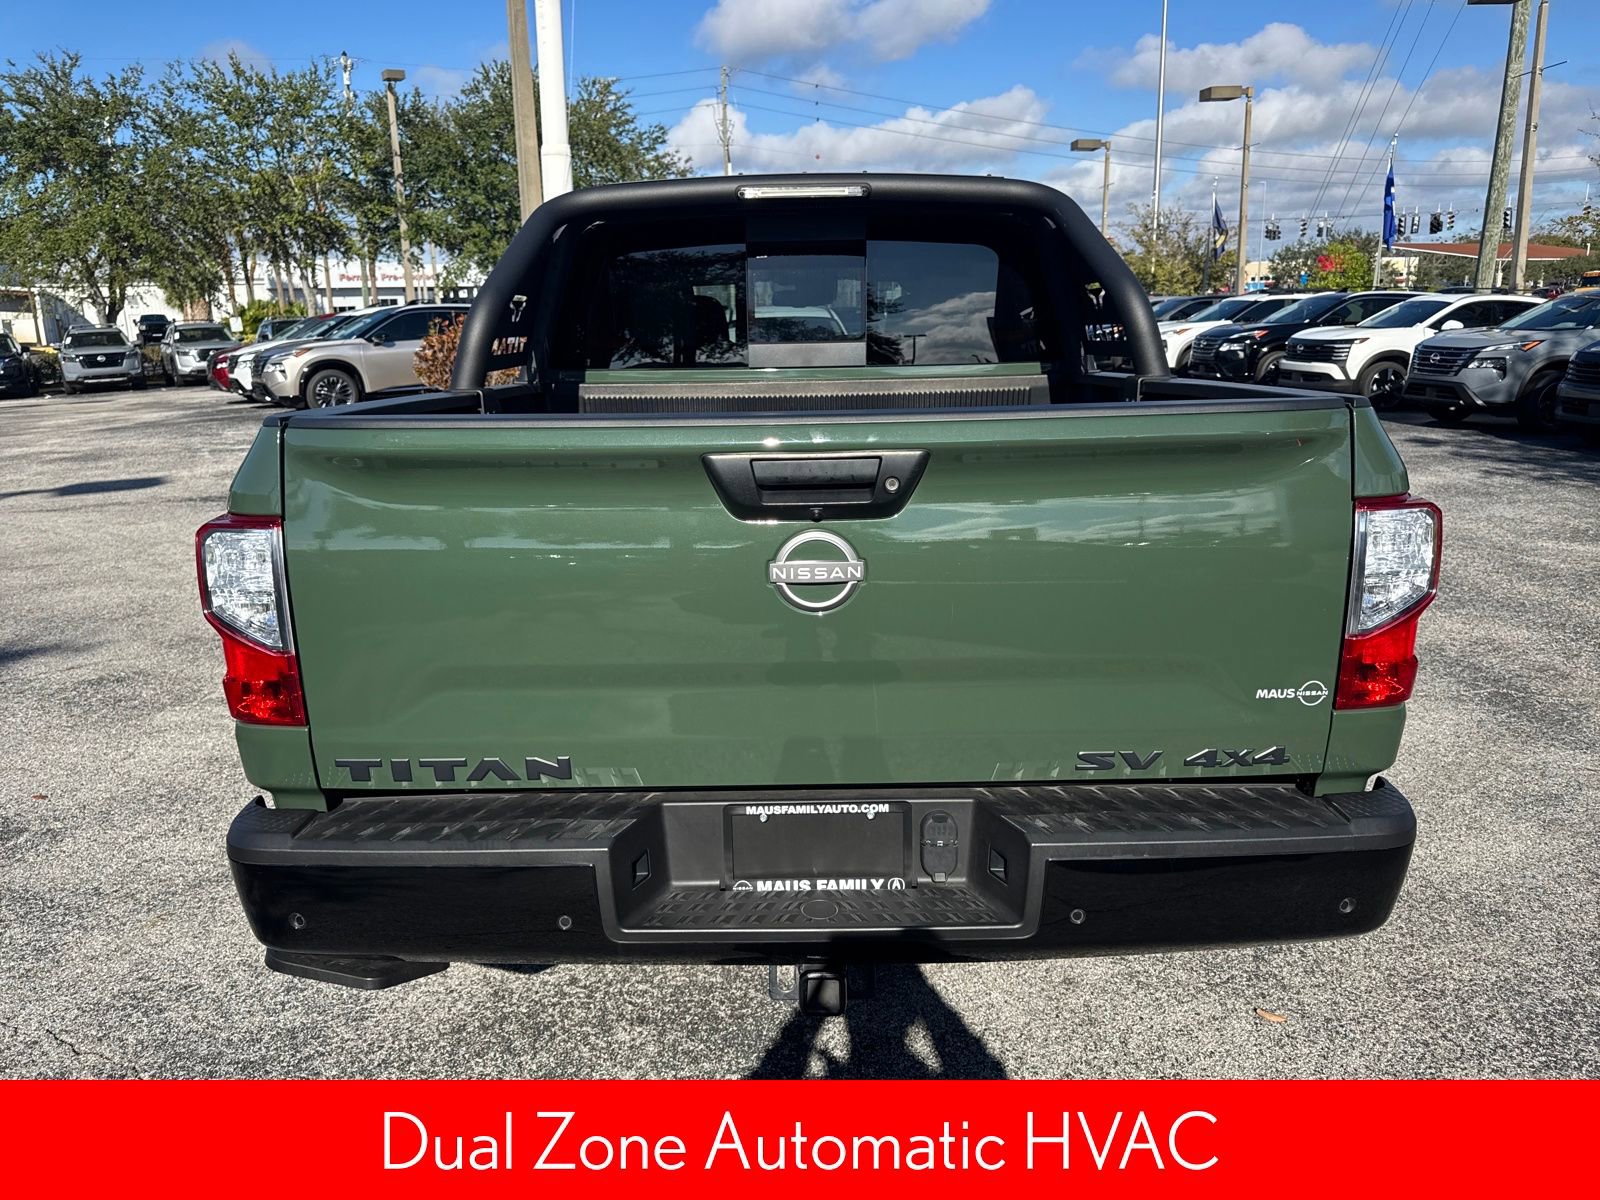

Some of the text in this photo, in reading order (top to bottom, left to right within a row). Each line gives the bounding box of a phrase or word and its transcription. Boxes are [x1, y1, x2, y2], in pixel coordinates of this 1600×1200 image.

[772, 566, 862, 580] NISSAN
[1255, 688, 1296, 699] MAUS
[1075, 750, 1164, 771] SV
[334, 756, 573, 782] TITAN
[745, 804, 890, 815] MAUSFAMILYAUTO.COM
[756, 879, 812, 891] MAUS
[816, 878, 885, 890] FAMILY
